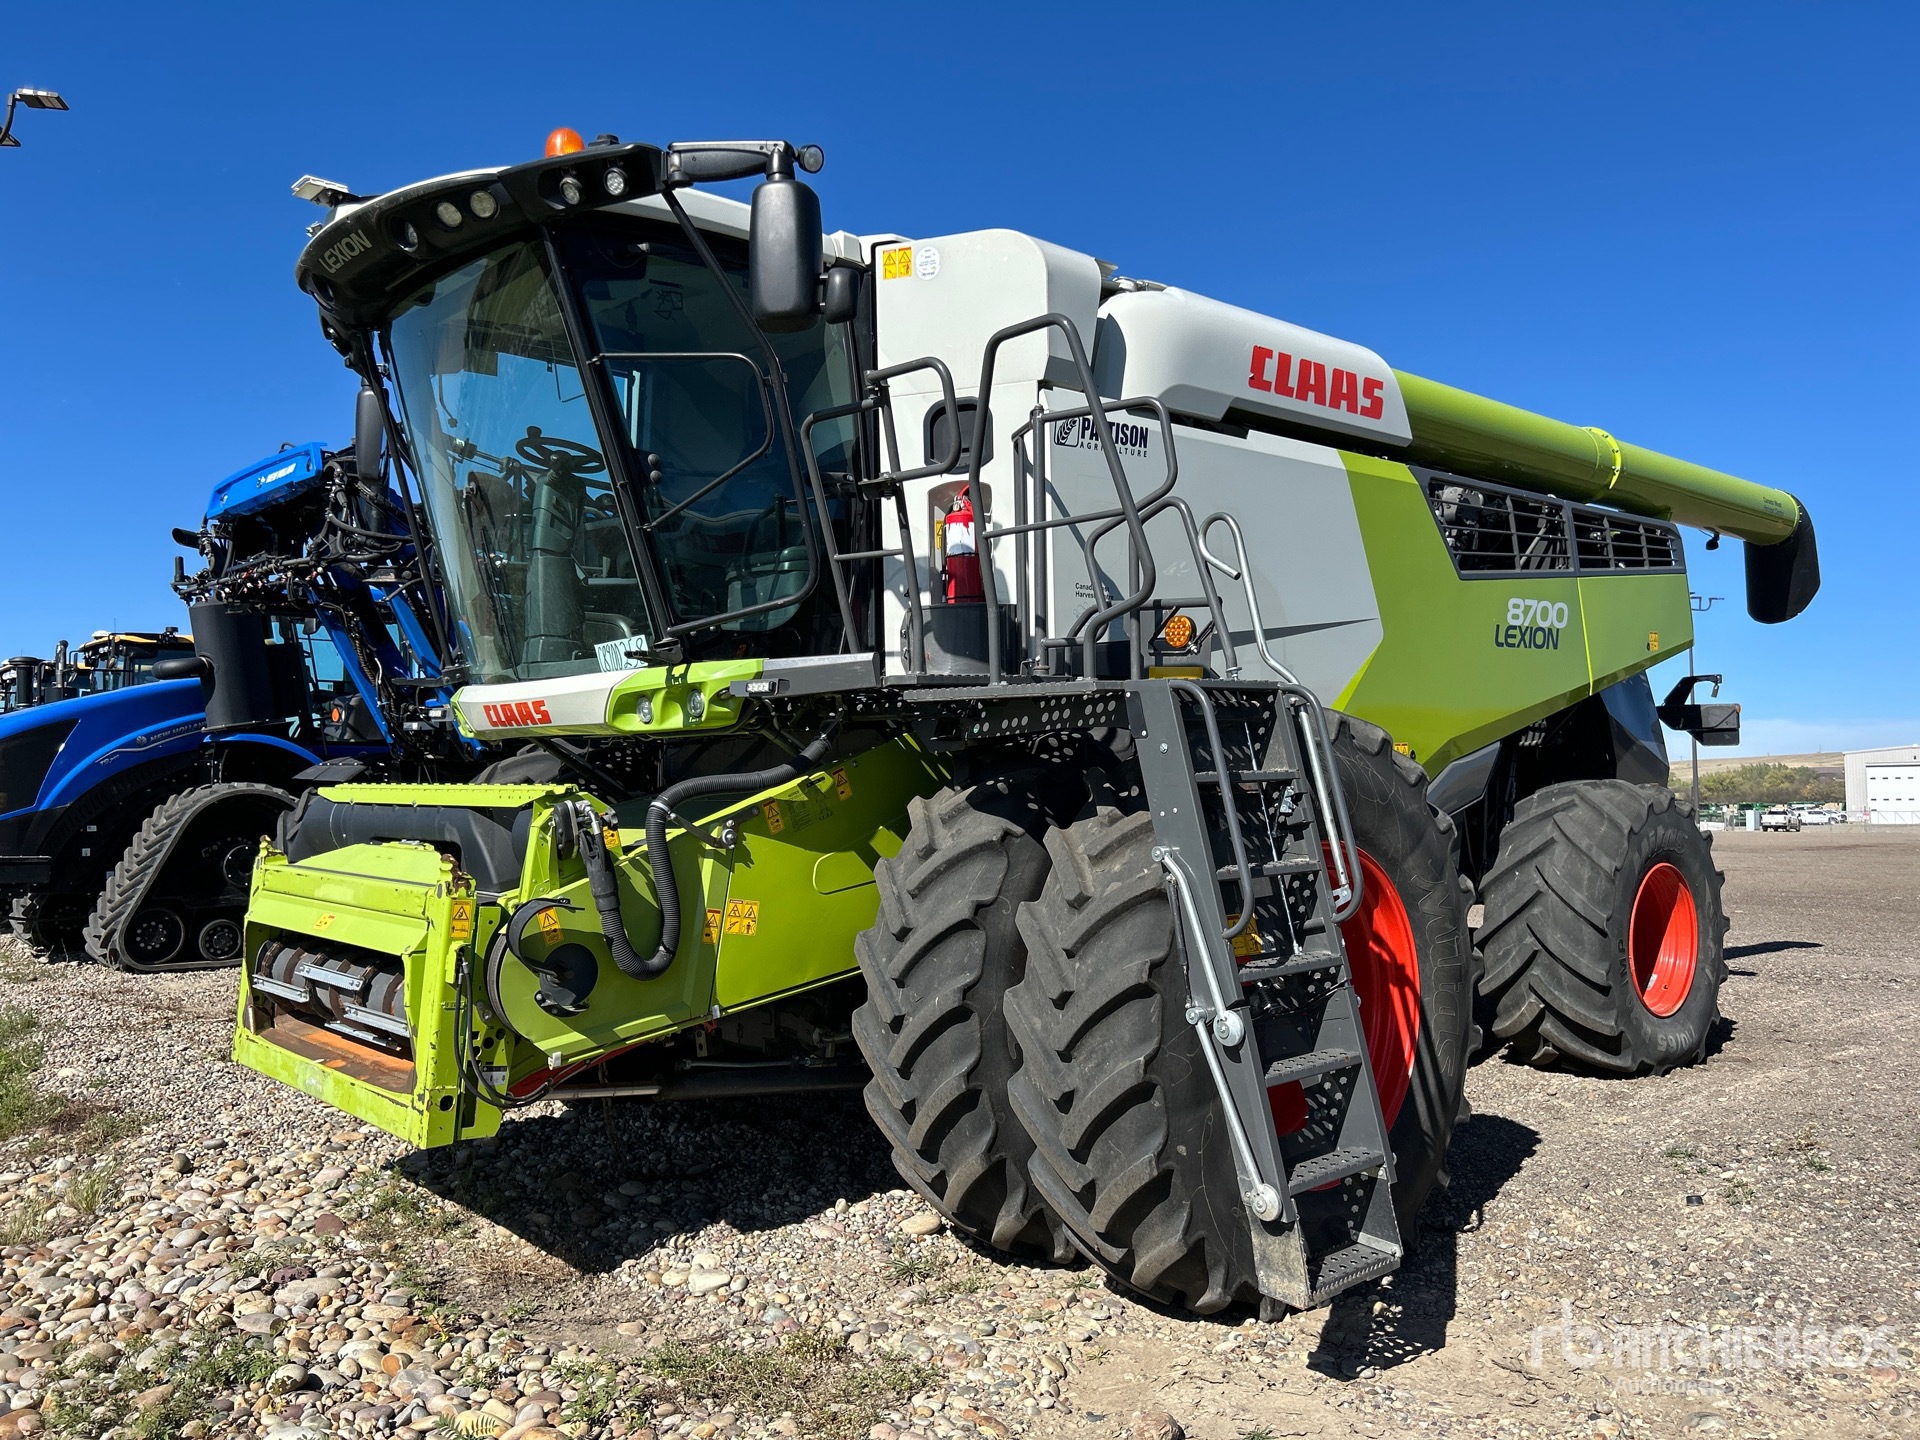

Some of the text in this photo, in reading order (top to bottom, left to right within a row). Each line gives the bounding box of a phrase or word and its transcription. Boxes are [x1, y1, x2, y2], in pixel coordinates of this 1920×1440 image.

[318, 229, 373, 274] LEXION
[1248, 345, 1385, 421] CLAAS
[1081, 417, 1149, 449] PATISON
[1075, 582, 1093, 592] Canad
[1075, 591, 1095, 599] Harves
[1507, 597, 1569, 629] 8700
[1495, 624, 1560, 650] LEXION
[483, 700, 552, 727] CLAAS
[150, 730, 171, 742] NEW
